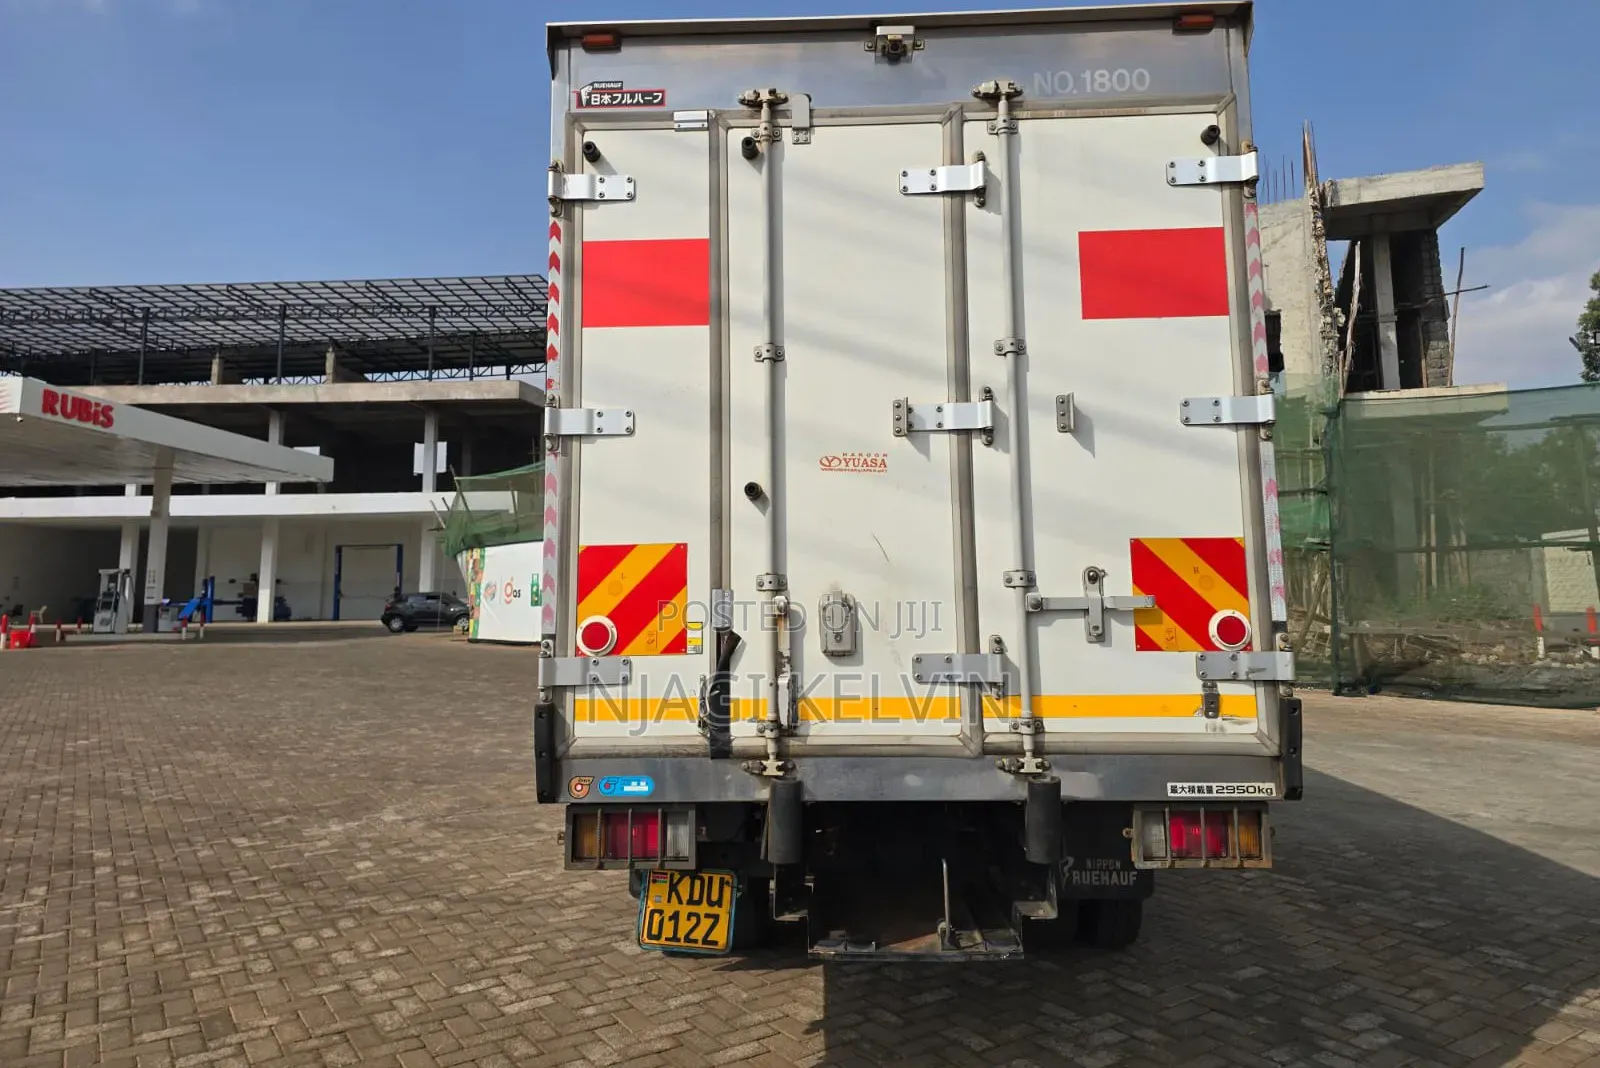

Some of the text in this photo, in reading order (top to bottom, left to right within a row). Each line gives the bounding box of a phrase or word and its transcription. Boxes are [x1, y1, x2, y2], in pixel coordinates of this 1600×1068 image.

[591, 92, 663, 106] 日本フルハーフ
[842, 458, 887, 468] YUASA
[1215, 785, 1273, 796] 2950kg
[1086, 859, 1121, 869] NIPPON
[667, 872, 725, 908] KDU
[646, 908, 720, 946] 012Z
